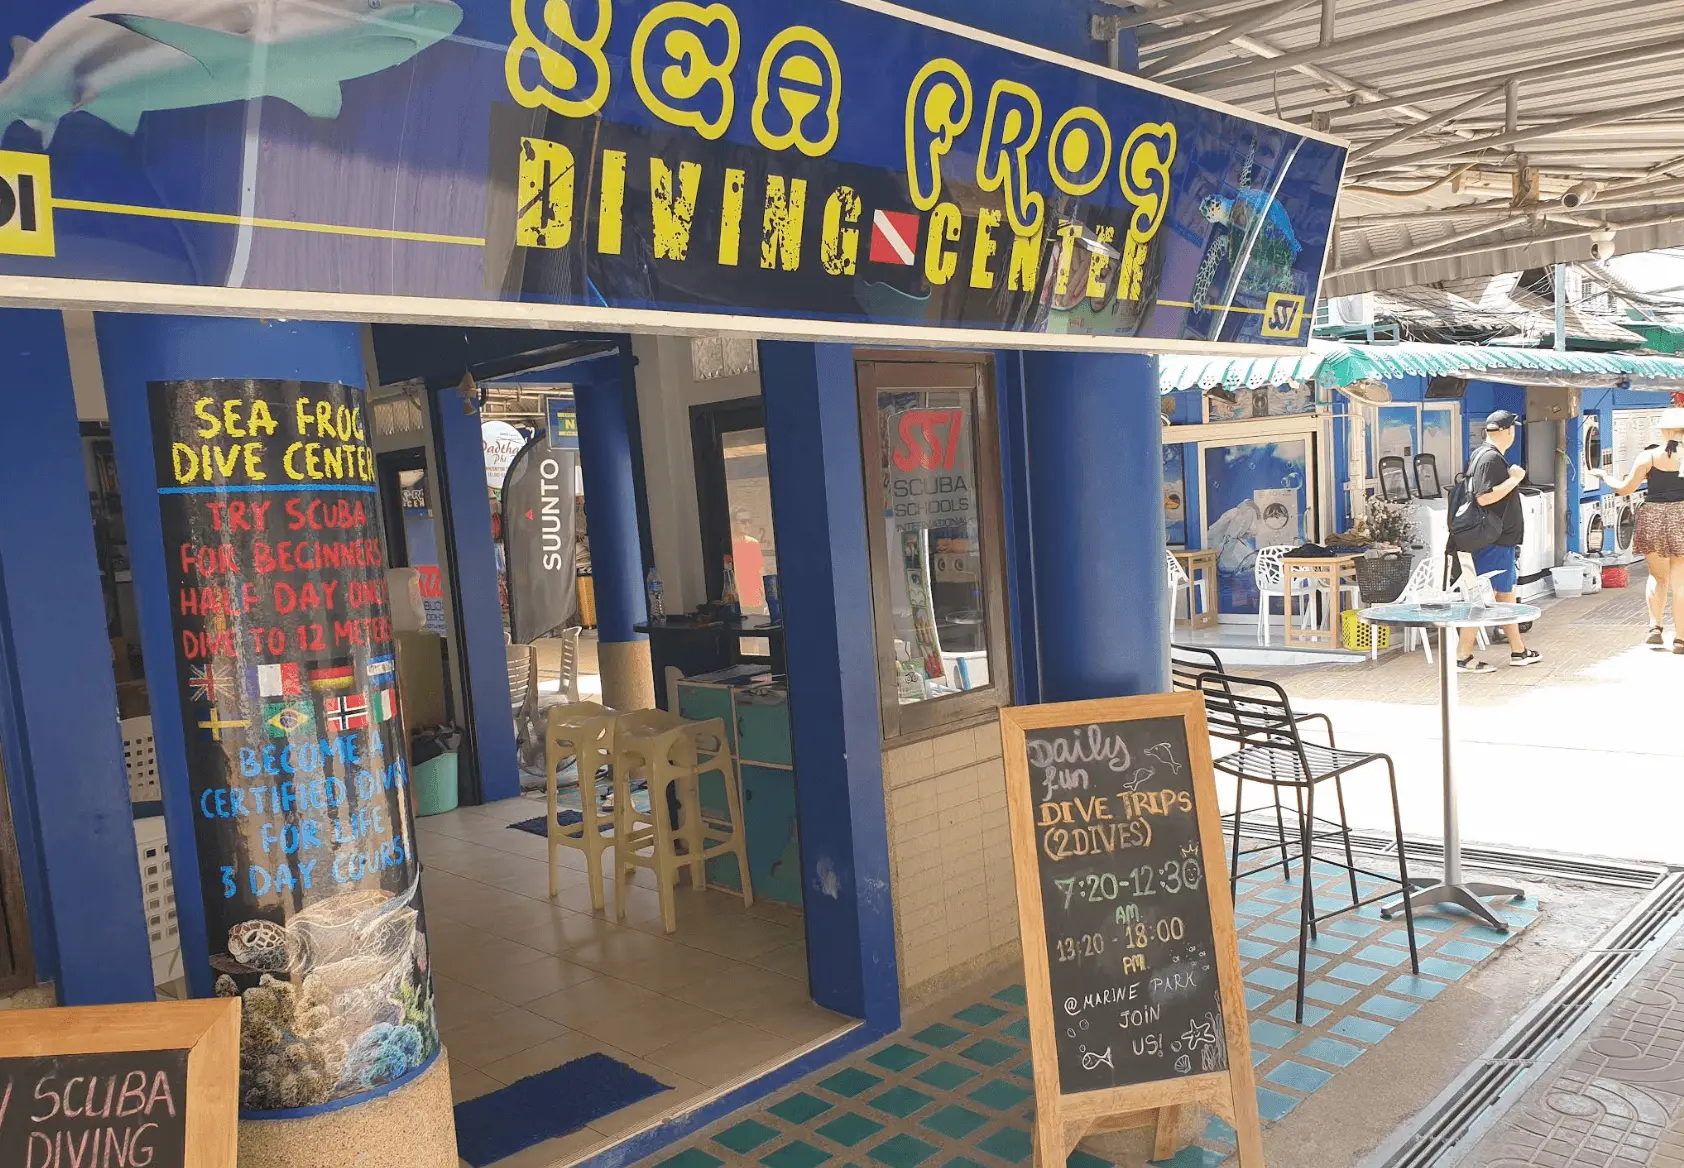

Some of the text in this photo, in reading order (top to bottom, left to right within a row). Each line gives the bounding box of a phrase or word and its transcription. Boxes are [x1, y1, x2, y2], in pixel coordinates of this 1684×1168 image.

[505, 0, 1177, 243] SEA FROG
[516, 137, 1150, 301] DIVING CENTER
[1268, 299, 1300, 331] SSI
[195, 397, 278, 438] SEA
[893, 410, 963, 473] SSI
[172, 441, 376, 484] DIVE CENTER
[894, 476, 968, 498] SCUBA
[895, 498, 969, 517] SCHOOLS
[206, 498, 368, 533] TRY SCUBA
[540, 458, 563, 571] SUUNTO
[180, 541, 241, 577] FOR
[180, 583, 261, 616] HALF
[273, 580, 339, 615] DAY
[182, 629, 242, 660] DIVE
[252, 627, 286, 657] TO
[298, 623, 328, 652] 12
[239, 730, 385, 778] BECOME A
[1028, 724, 1131, 772] Daily
[200, 776, 347, 819] CERTIFIED
[1038, 788, 1193, 827] DIVE TRIPS
[261, 806, 385, 855] FOR LIFE
[220, 864, 238, 899] 3
[249, 858, 318, 897] DAY
[1150, 972, 1198, 993] PARK
[1132, 1033, 1164, 1057] US!
[30, 1070, 176, 1123] SCUBA
[26, 1122, 159, 1168] DIVING
